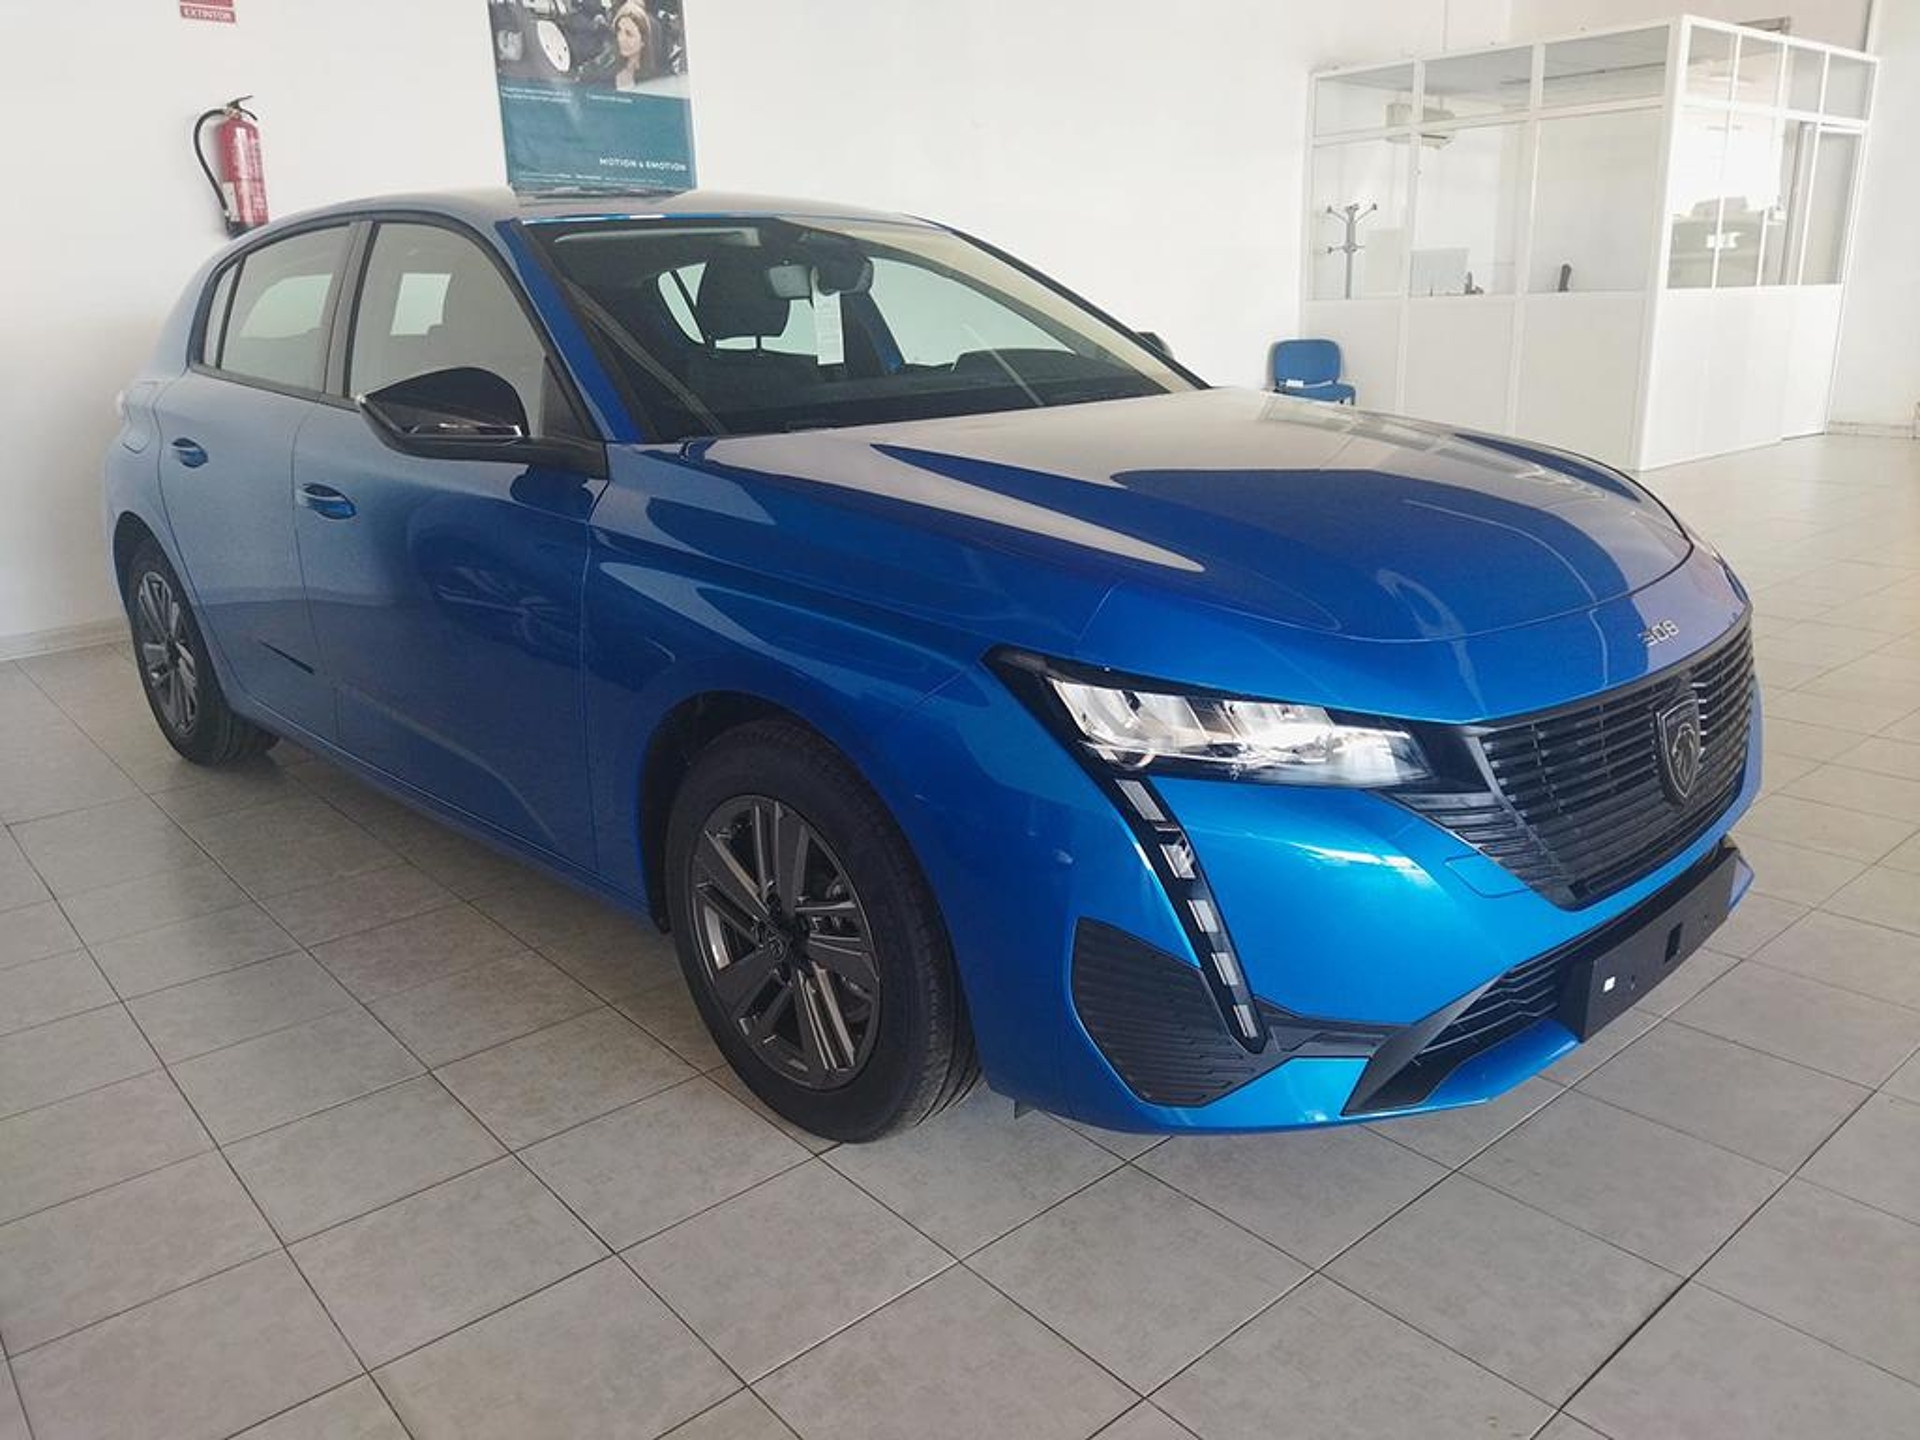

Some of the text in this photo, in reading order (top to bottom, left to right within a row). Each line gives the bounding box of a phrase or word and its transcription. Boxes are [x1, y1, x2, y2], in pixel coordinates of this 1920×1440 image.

[599, 157, 636, 168] MOTION
[645, 160, 687, 172] EMOTION
[1637, 619, 1680, 646] 308
